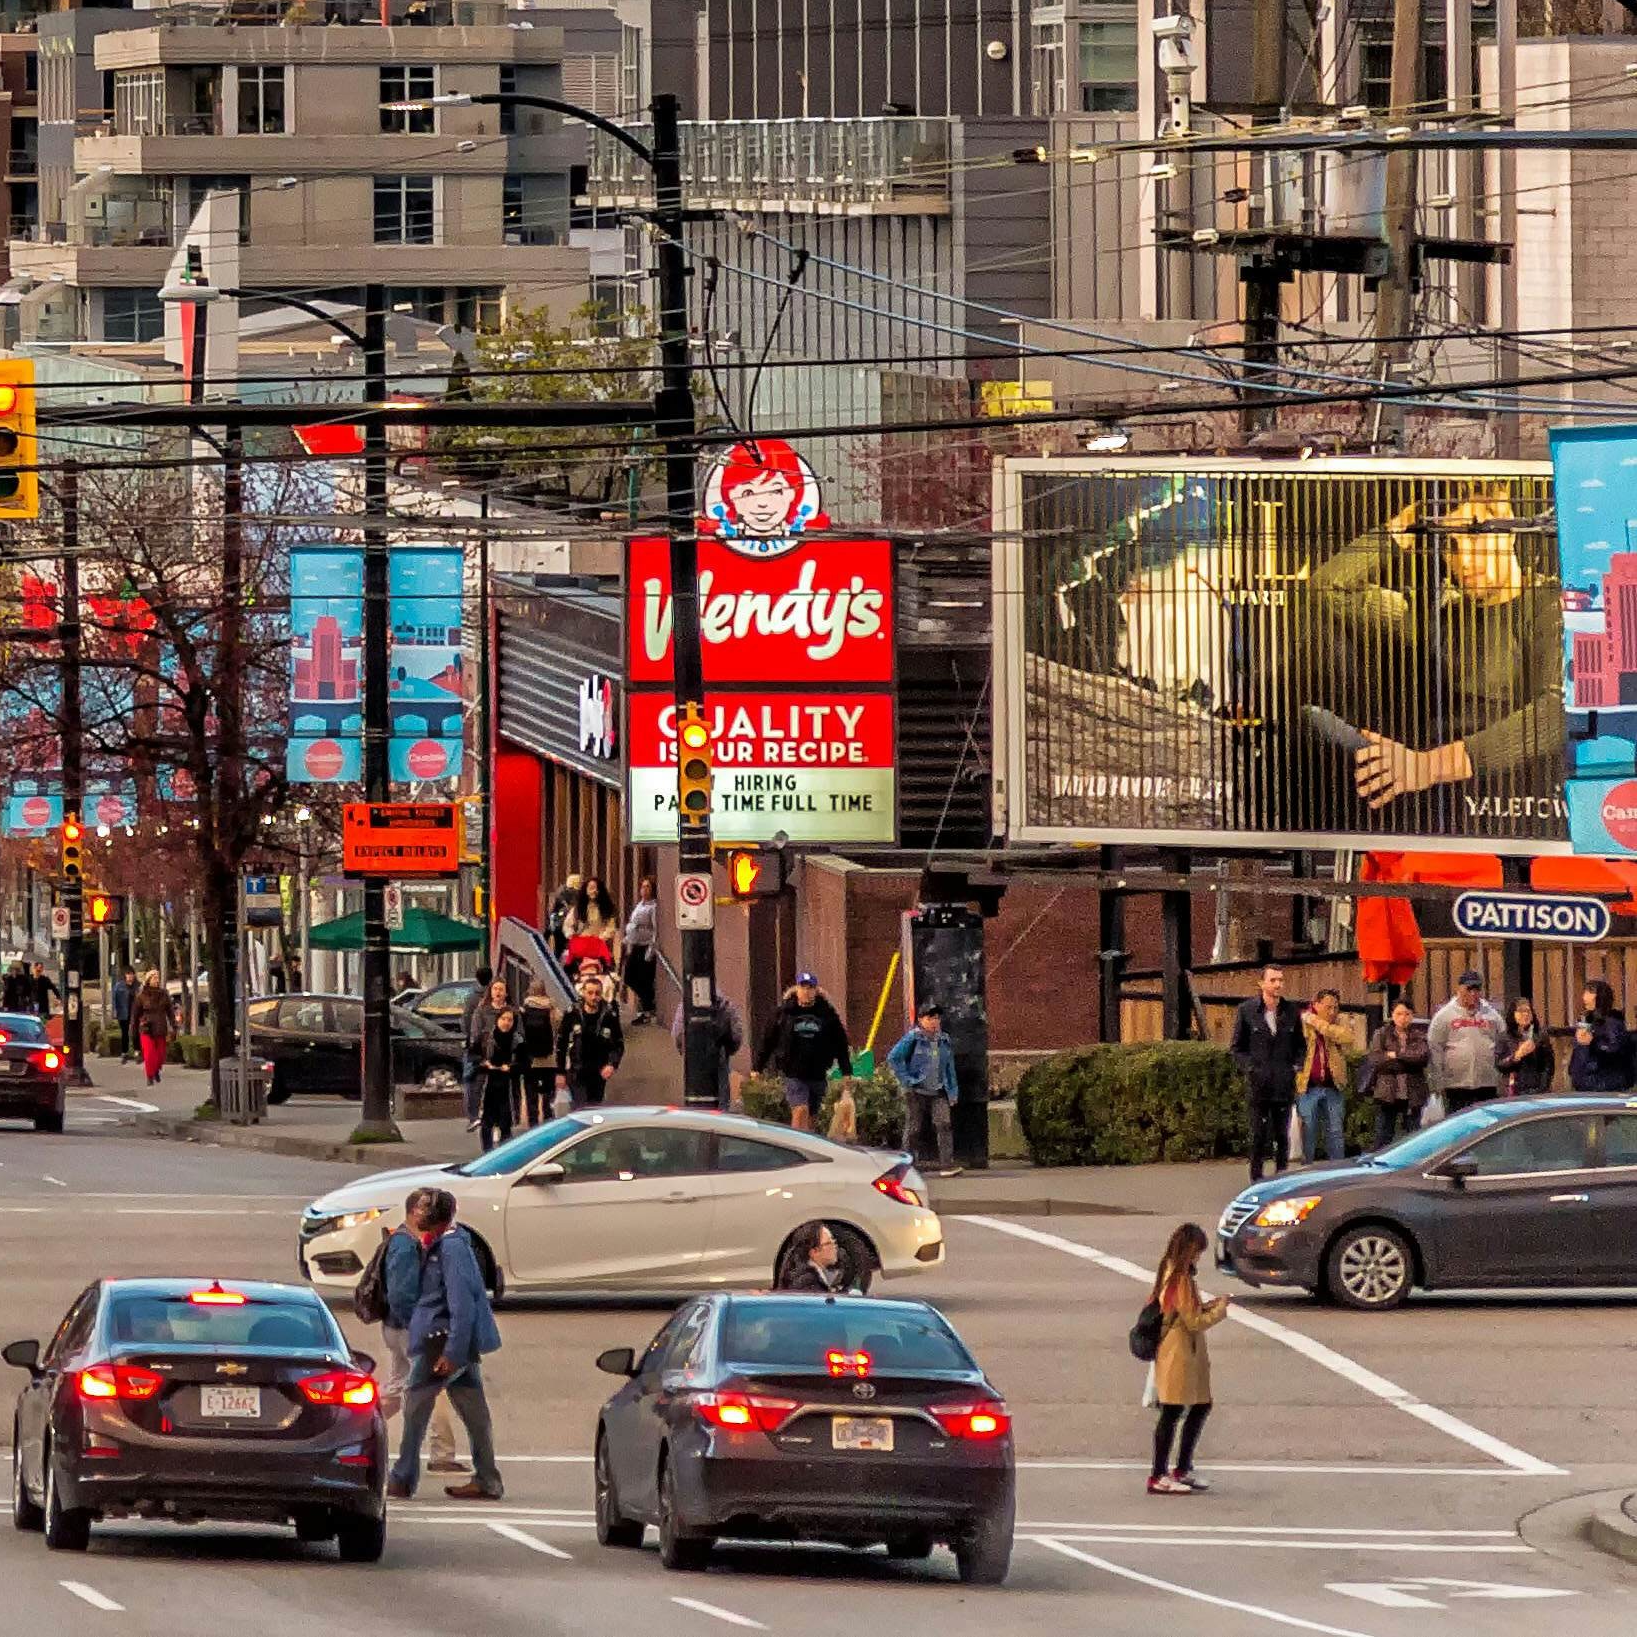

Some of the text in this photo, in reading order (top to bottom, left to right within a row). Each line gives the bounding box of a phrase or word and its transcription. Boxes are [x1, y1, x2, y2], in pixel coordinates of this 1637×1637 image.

[710, 742, 754, 762] UR
[734, 775, 797, 792] HIRING
[722, 795, 764, 811] TIME
[772, 795, 817, 811] FULL
[830, 795, 872, 811] TIME
[1466, 900, 1597, 932] PATTISON
